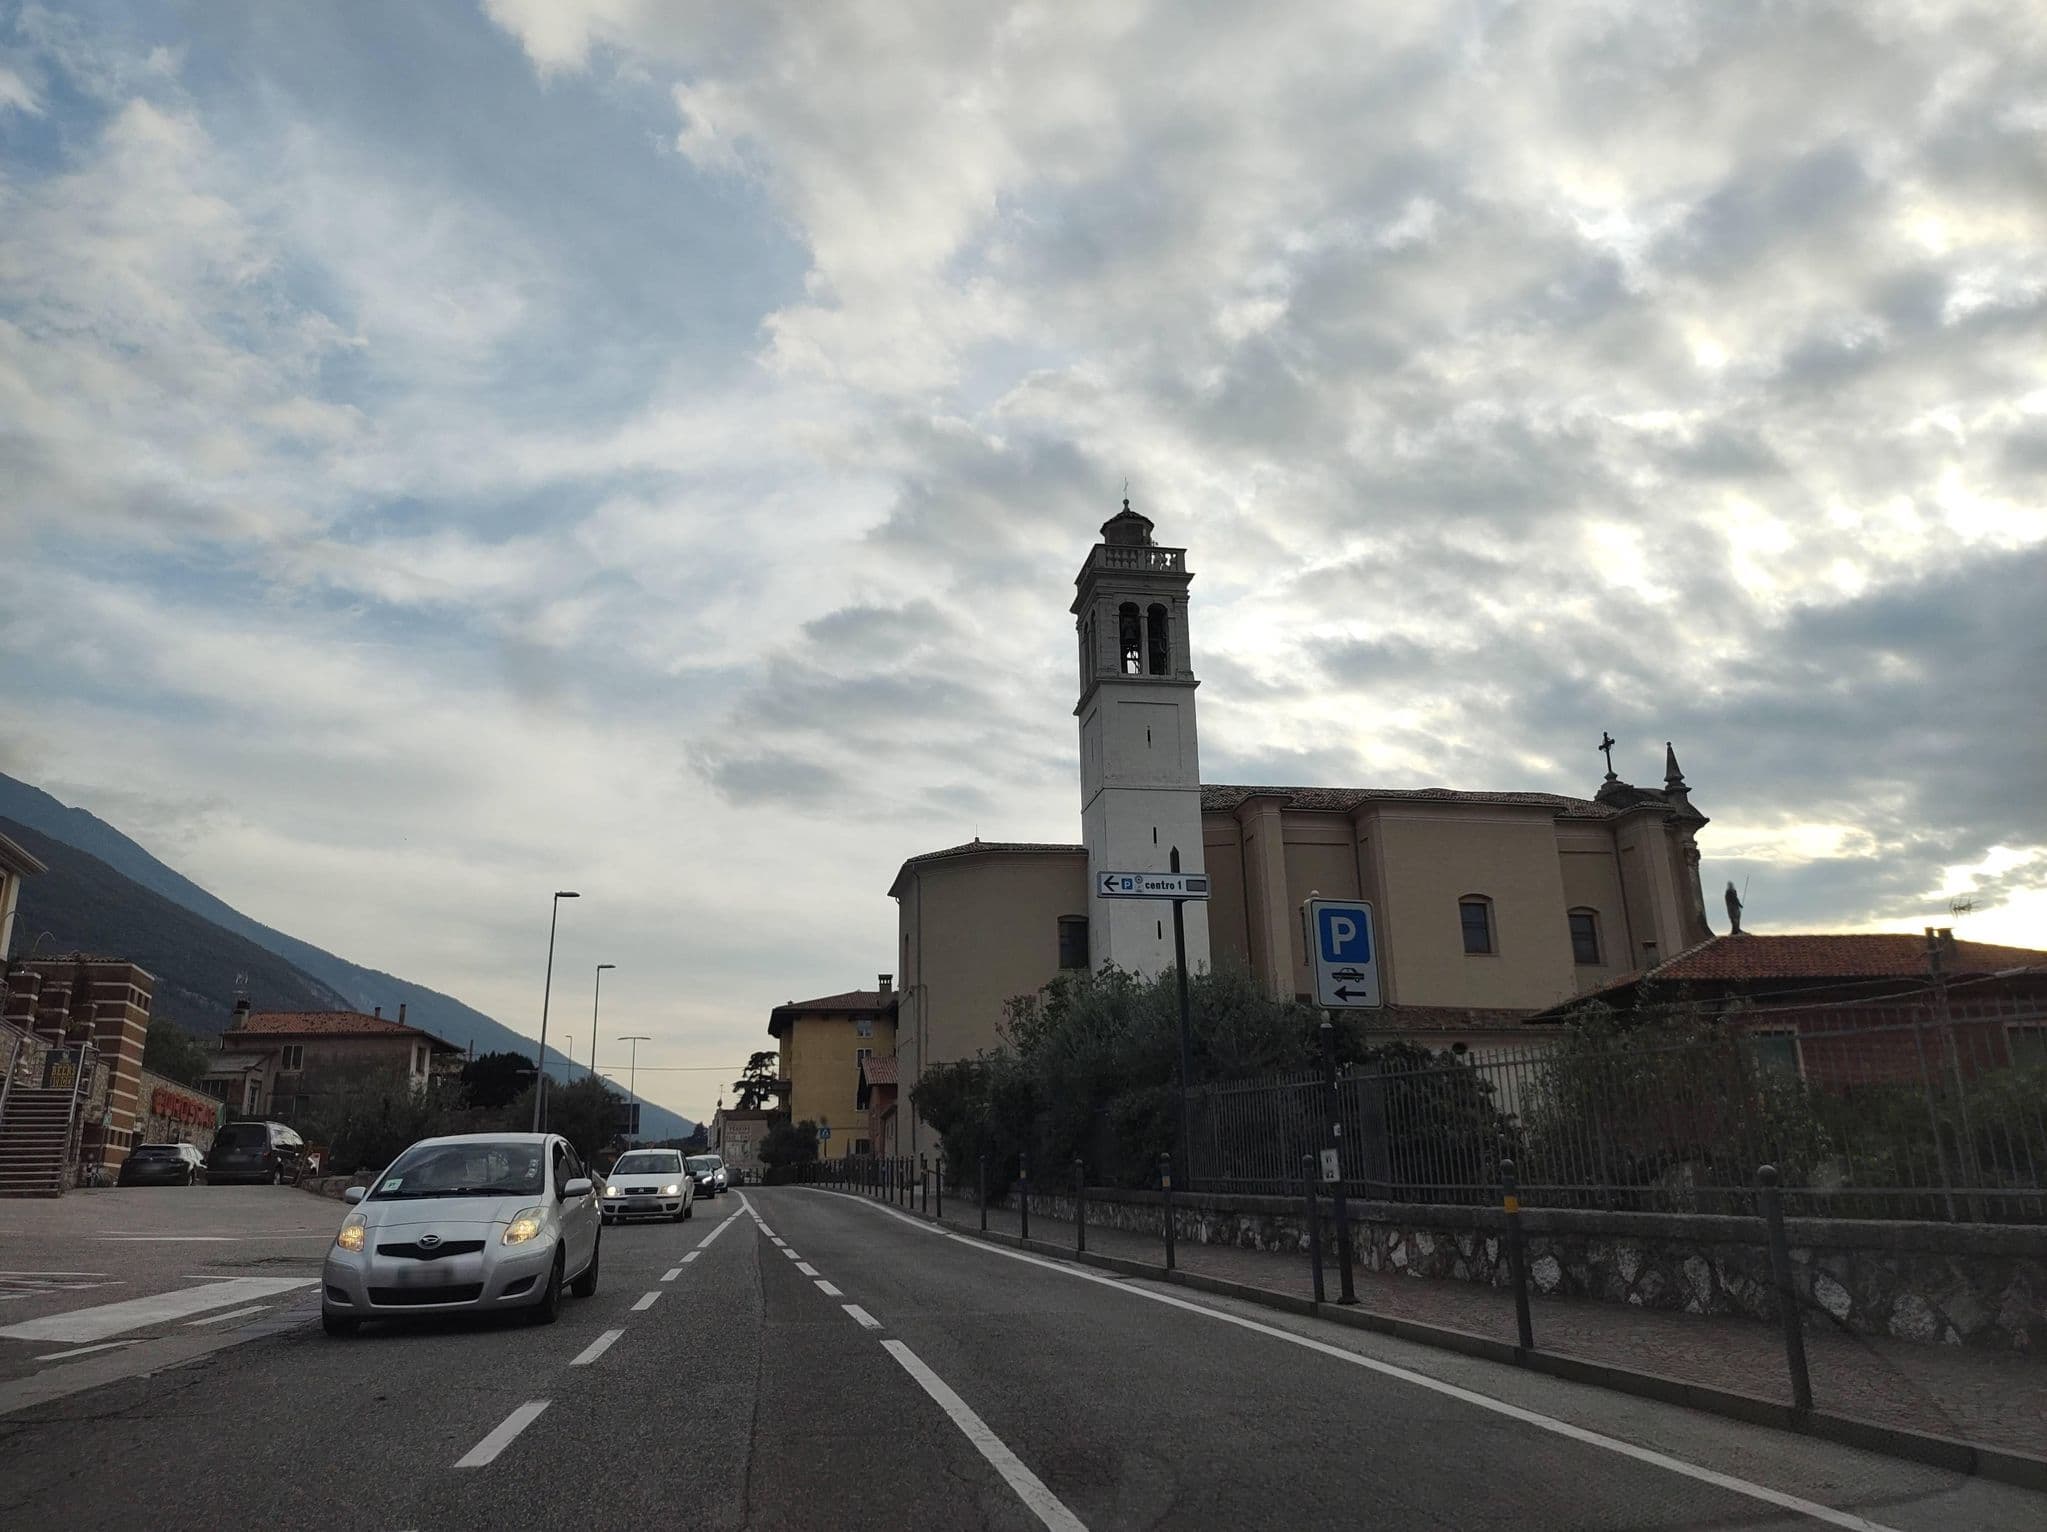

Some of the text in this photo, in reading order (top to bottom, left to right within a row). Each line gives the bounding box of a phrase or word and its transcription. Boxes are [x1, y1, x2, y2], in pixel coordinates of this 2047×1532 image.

[1145, 880, 1175, 890] centro
[1178, 881, 1182, 890] 1
[1330, 916, 1356, 955] P
